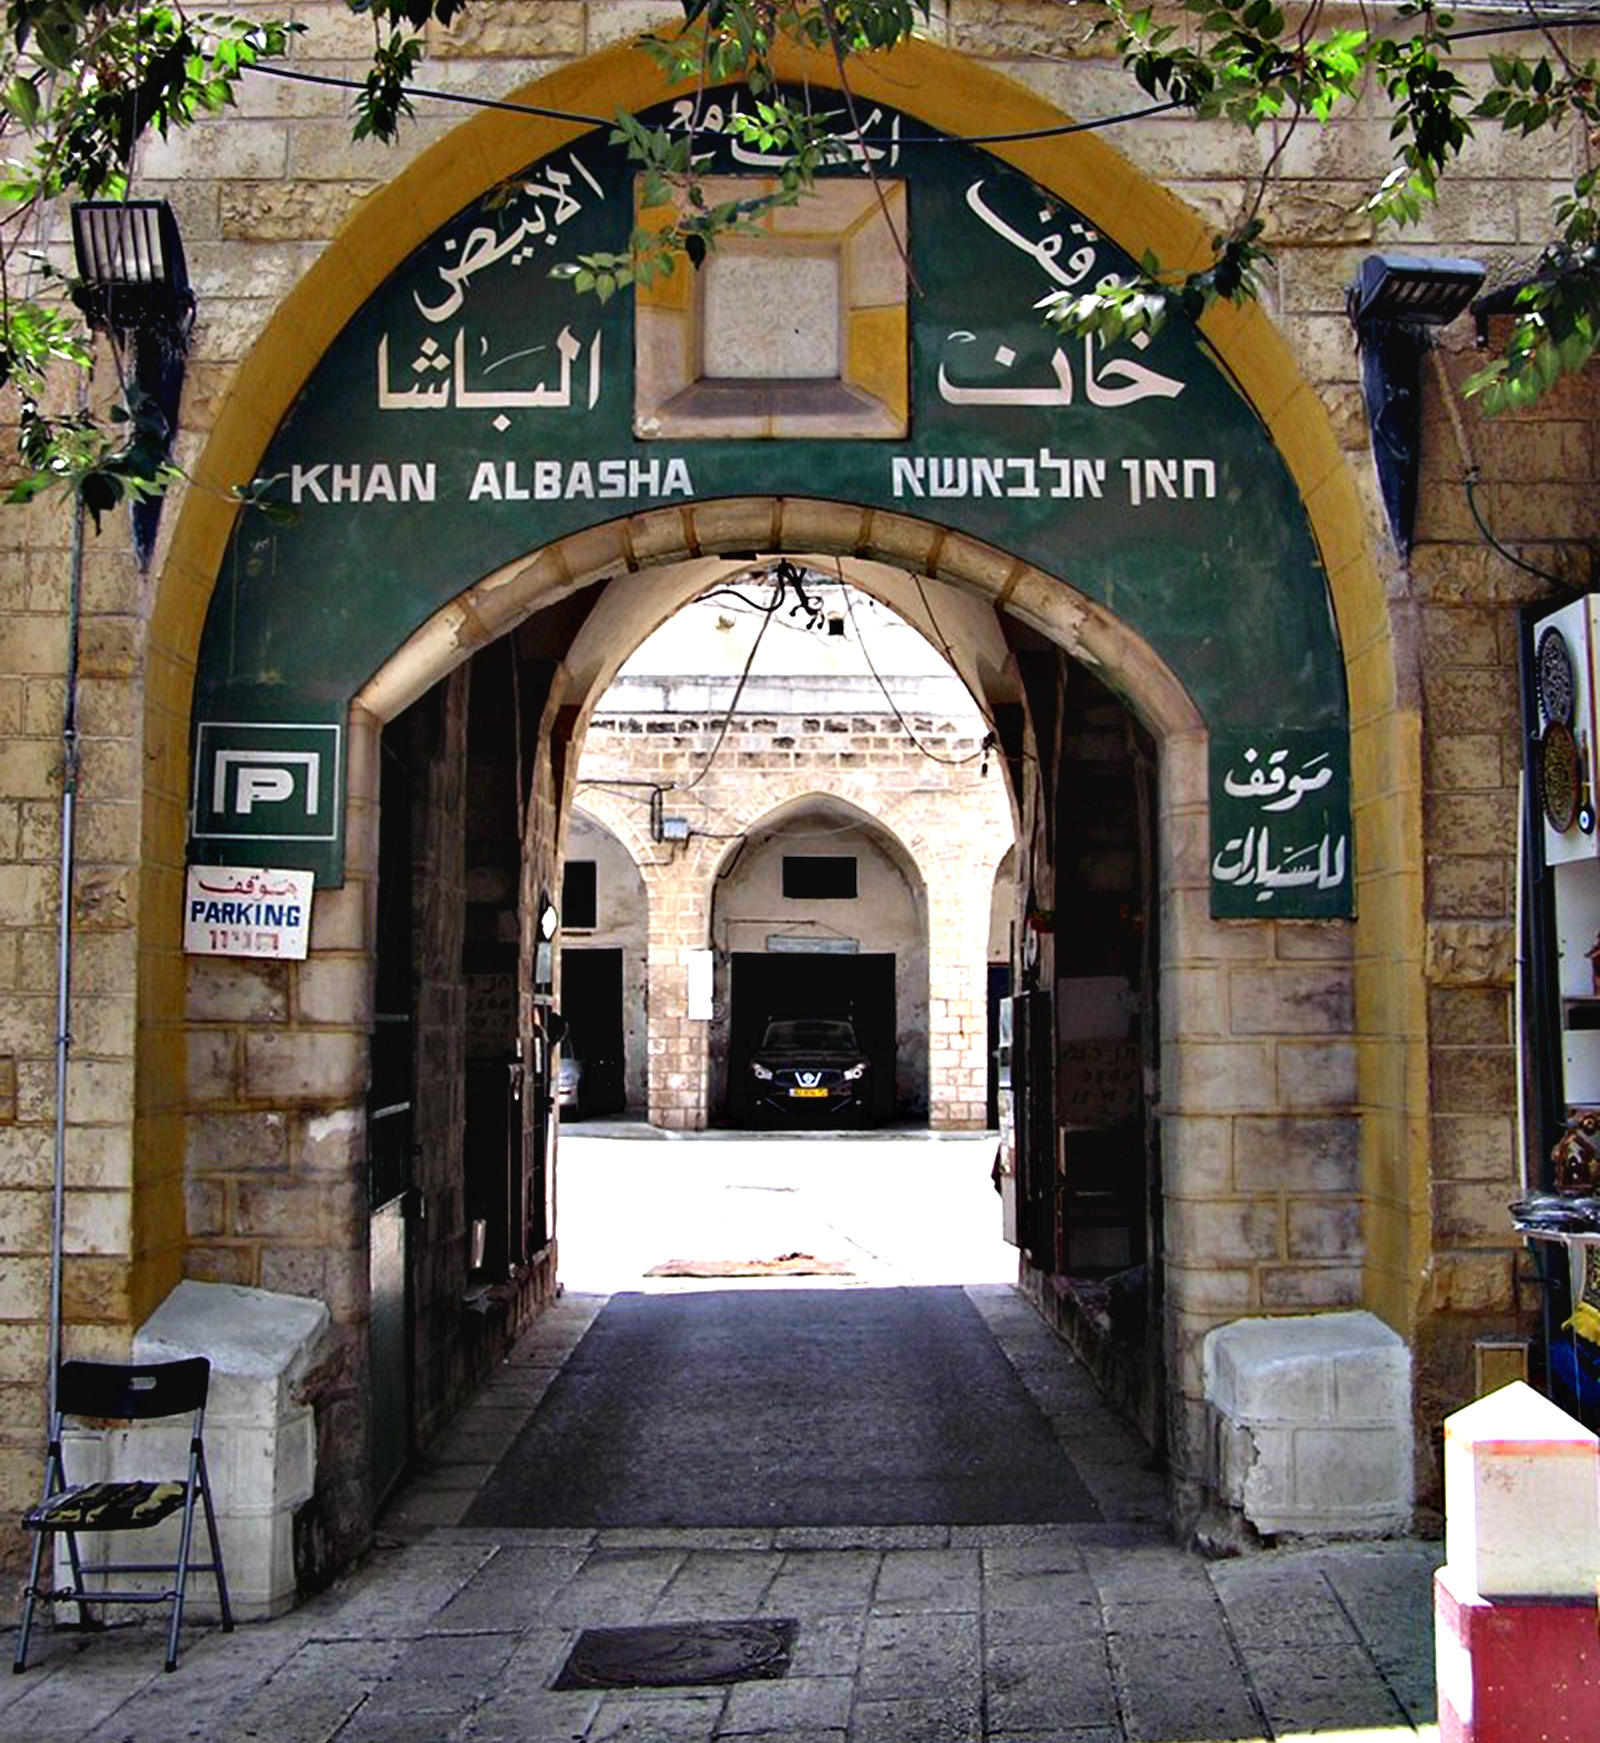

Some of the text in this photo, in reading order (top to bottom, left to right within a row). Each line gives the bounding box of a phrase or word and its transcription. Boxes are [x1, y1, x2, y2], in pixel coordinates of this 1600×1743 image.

[378, 325, 602, 432] الباشا
[291, 457, 695, 503] KHAN ALBASHA
[892, 448, 1215, 506] חאן אלבאשא
[198, 875, 298, 902] موقف
[191, 901, 301, 928] PARKING
